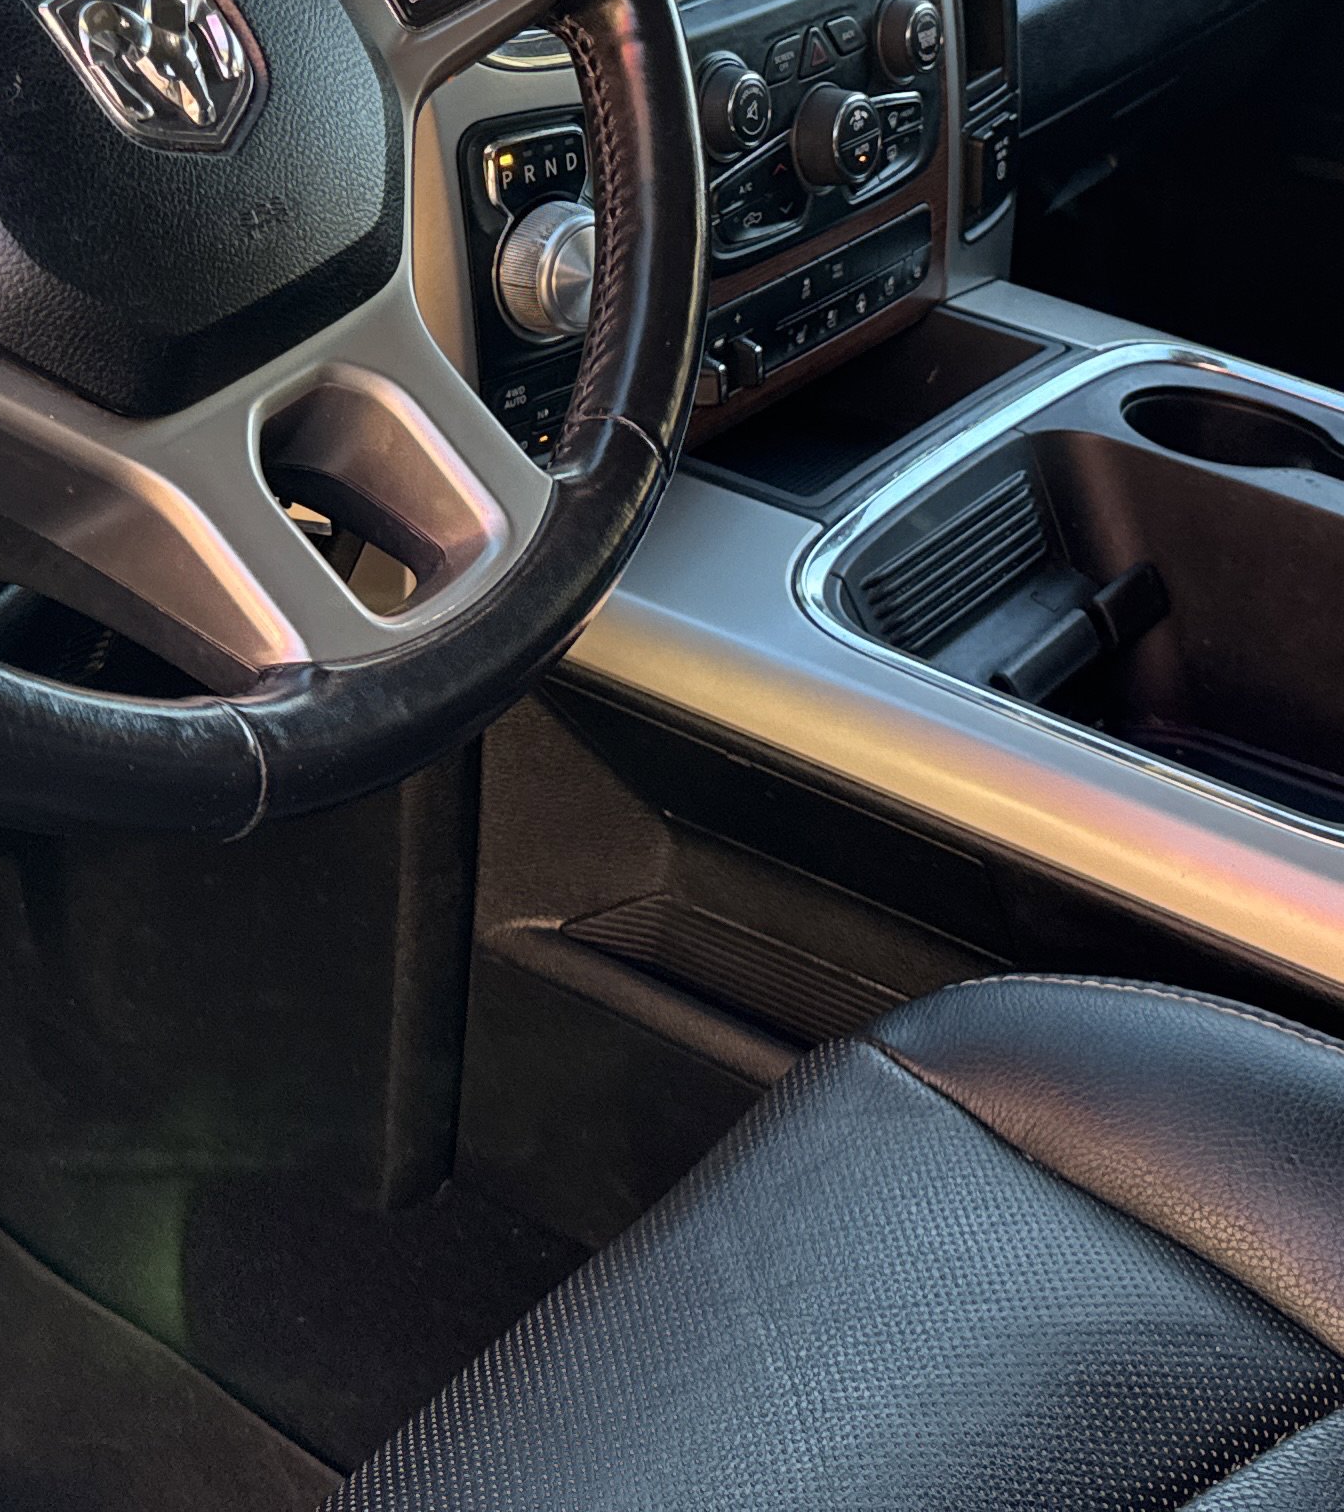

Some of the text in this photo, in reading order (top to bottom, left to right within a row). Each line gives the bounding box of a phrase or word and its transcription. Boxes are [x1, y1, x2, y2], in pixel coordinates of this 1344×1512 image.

[545, 157, 558, 178] N
[565, 152, 578, 171] D
[502, 171, 513, 190] P
[524, 164, 536, 184] R
[503, 394, 527, 410] AUTO
